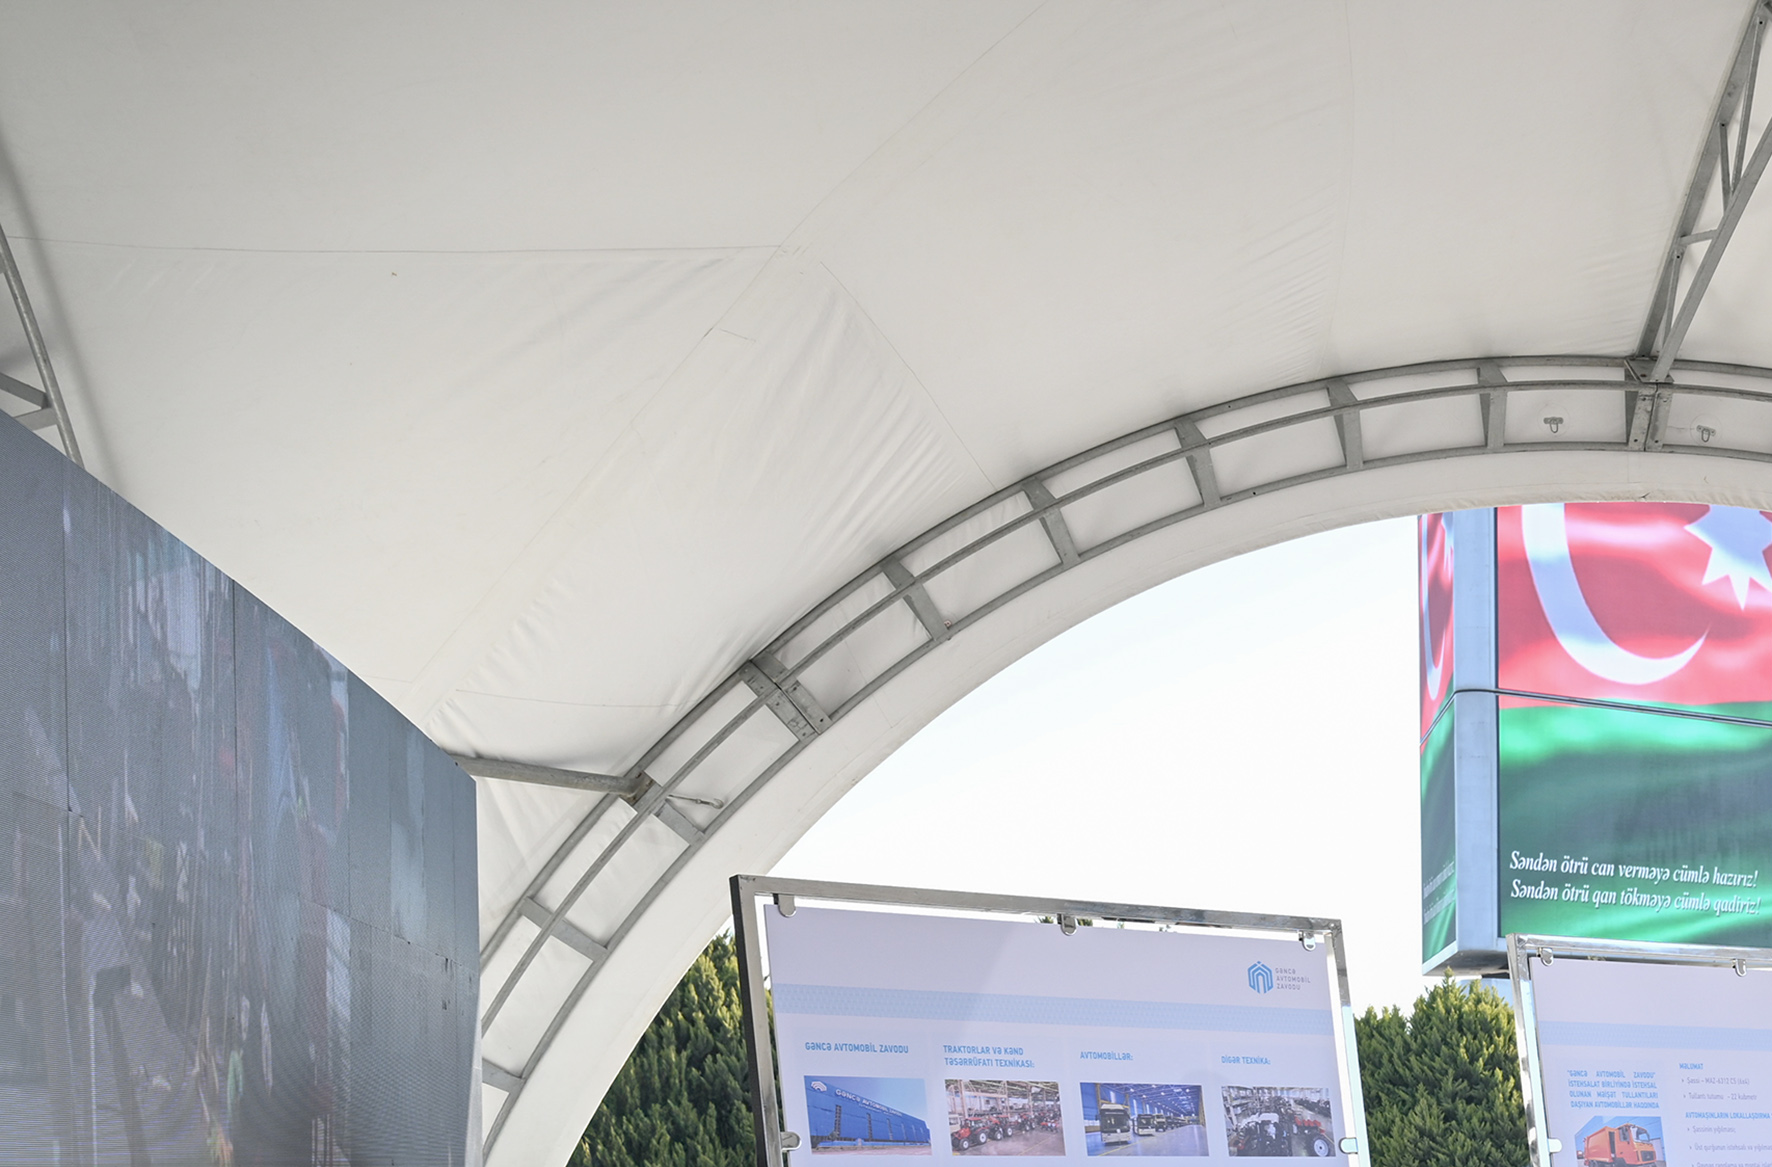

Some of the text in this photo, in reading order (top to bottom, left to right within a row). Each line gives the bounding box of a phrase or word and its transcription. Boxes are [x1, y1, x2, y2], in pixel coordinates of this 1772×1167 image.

[1510, 851, 1759, 888] Səndən ötrü can verməyə cümlə hazırız!
[1511, 879, 1761, 917] Səndən ötrü qan tökməyə cümlə qadiriz!
[804, 1042, 908, 1053] GƏNCƏ AVTOMOBİL ZAVODU
[943, 1044, 1024, 1055] TRAKTORLAR VƏ KƏND
[944, 1056, 993, 1066] TƏSƏRRÜFATI
